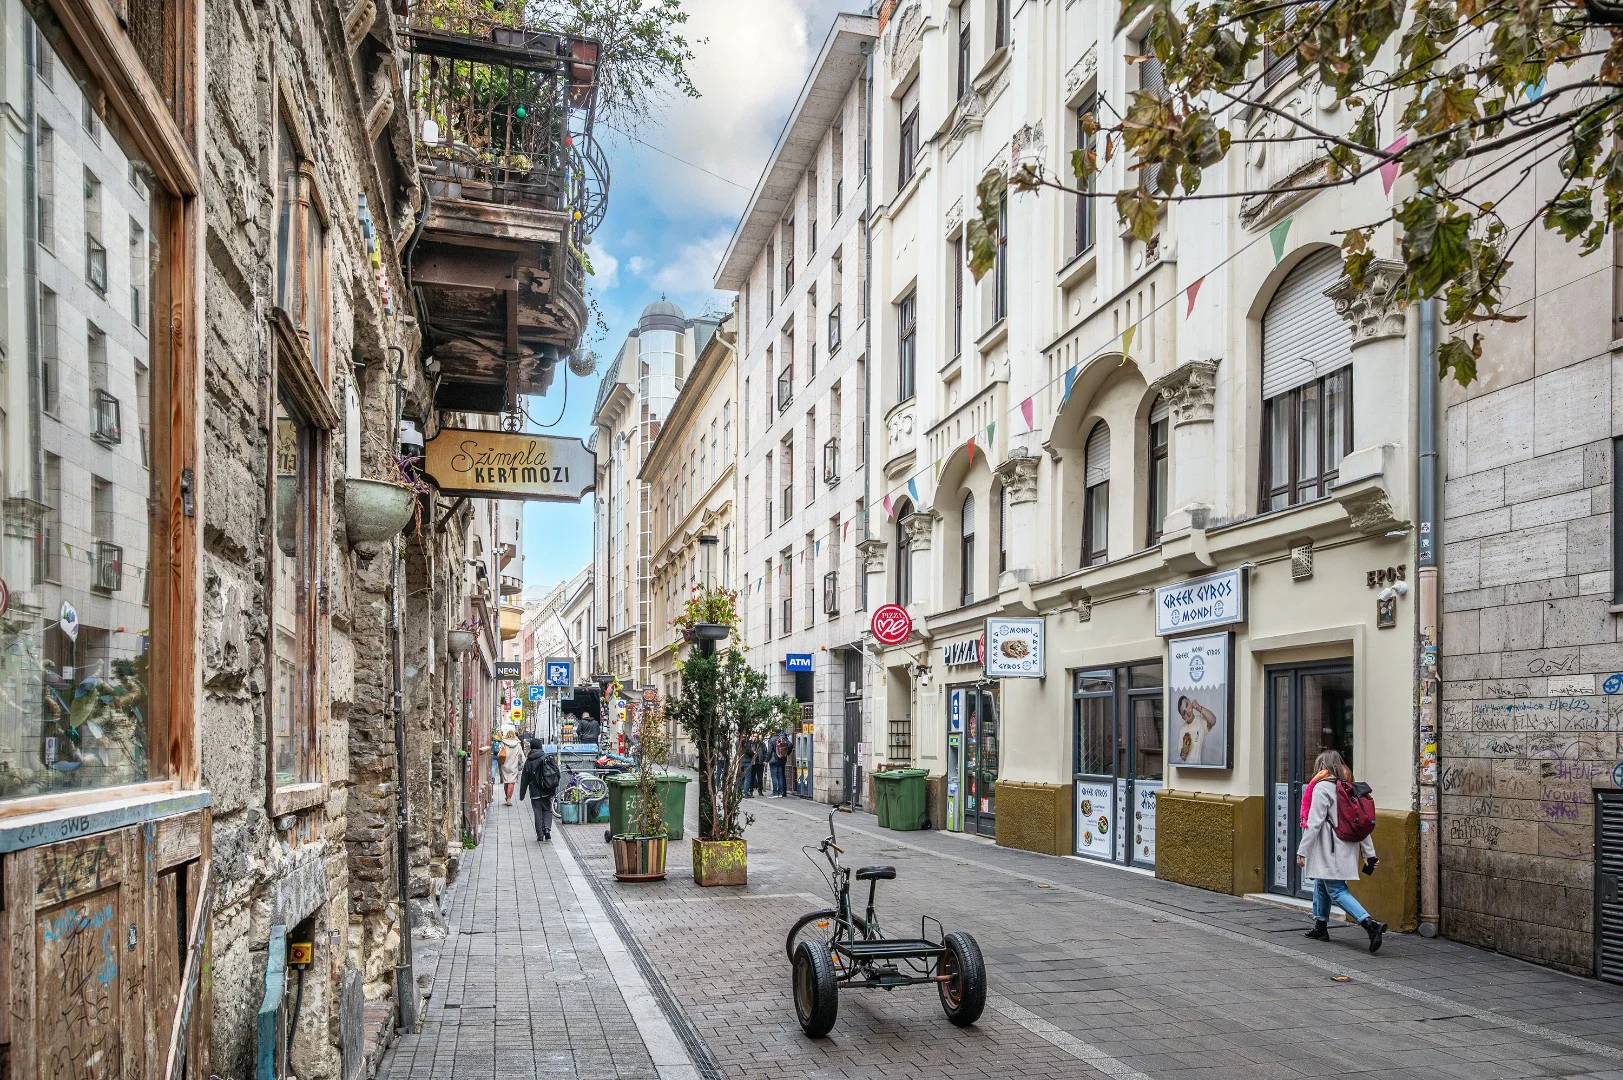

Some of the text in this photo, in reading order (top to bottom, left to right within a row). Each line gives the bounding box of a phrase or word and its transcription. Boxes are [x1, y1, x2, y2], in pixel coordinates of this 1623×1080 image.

[451, 440, 547, 477] Szimpla
[475, 466, 570, 483] KERTMOZI
[1366, 564, 1406, 587] EPOS
[1163, 580, 1232, 609] GREEK GYROS
[1182, 605, 1212, 622] MONDI
[789, 658, 811, 666] ATM
[944, 640, 978, 665] PIZZA
[1206, 648, 1221, 657] GYROS
[497, 667, 519, 675] NEON
[61, 815, 90, 836] SWB
